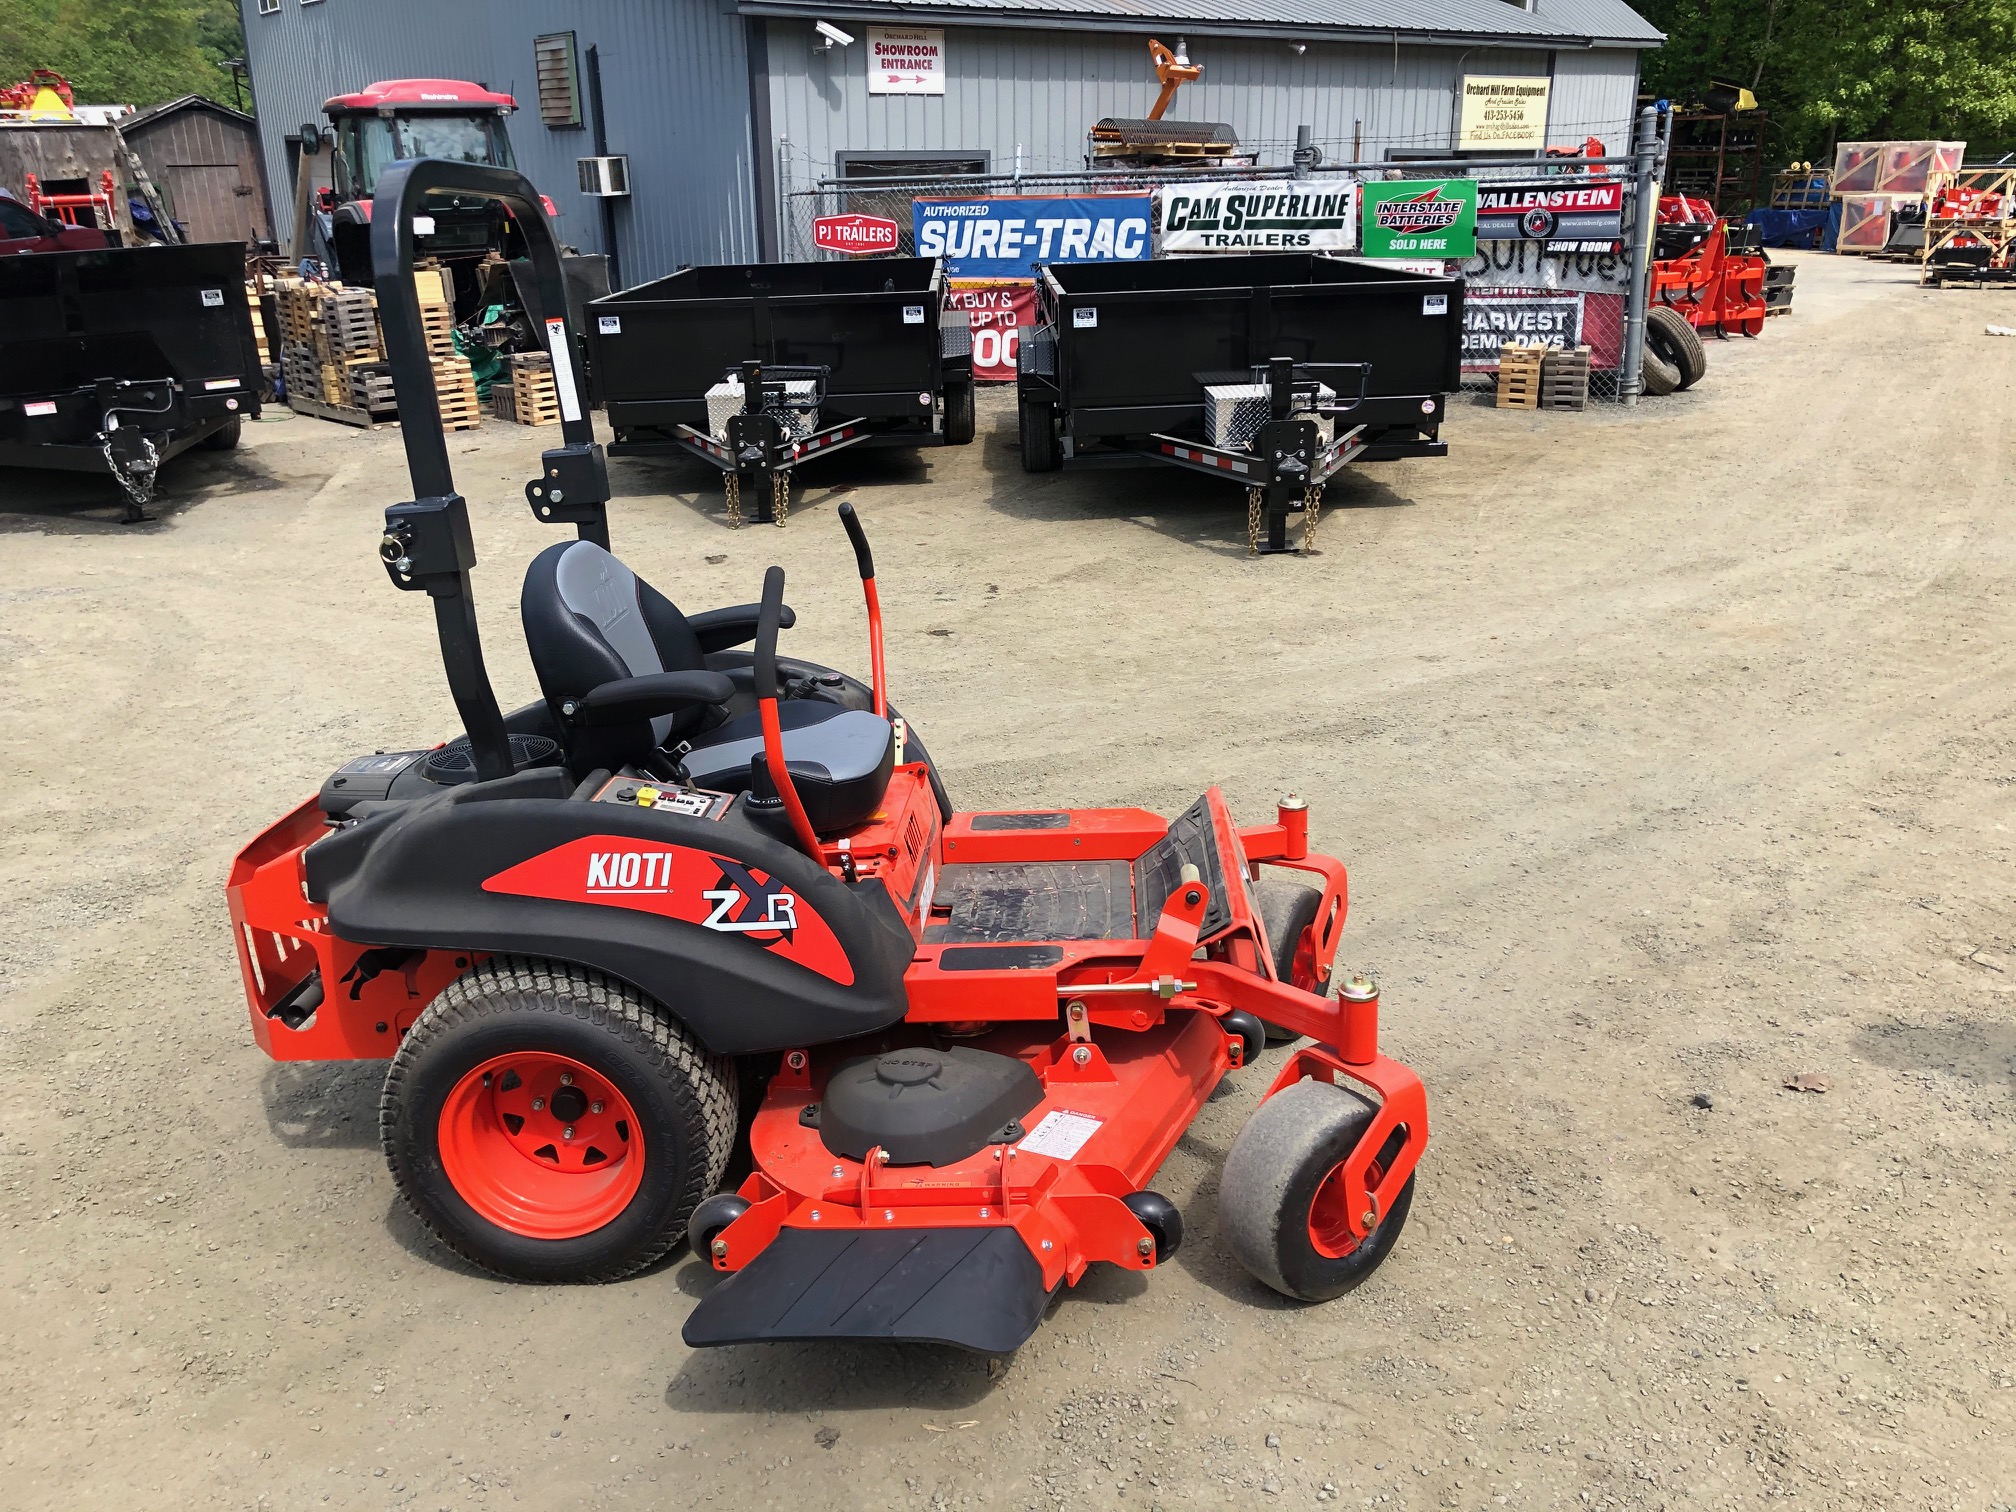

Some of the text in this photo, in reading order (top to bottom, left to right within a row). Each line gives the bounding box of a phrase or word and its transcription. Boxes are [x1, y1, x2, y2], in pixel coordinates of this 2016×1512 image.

[874, 42, 938, 56] SHOWROOM
[881, 58, 933, 70] ENTRANCE
[1466, 83, 1546, 97] Orchard Hill Farm Equipment
[1484, 110, 1524, 120] 413-253-5456
[923, 205, 989, 217] AUTHORIZED
[1166, 197, 1221, 232] CAM
[1222, 194, 1350, 231] SUPERLINE
[1377, 202, 1461, 213] INTERSTATE
[1380, 214, 1454, 225] BATTERIES
[819, 225, 892, 242] PJ TRAILERS
[919, 217, 1147, 259] SURE-TRAC
[1201, 234, 1311, 247] TRAILERS
[1389, 239, 1447, 250] SOLD HERE
[1547, 242, 1612, 253] SHOW ROOM
[963, 292, 997, 308] BUY
[1001, 292, 1013, 308] &
[970, 311, 1016, 327] UP TO
[1463, 311, 1567, 330] HARVEST
[586, 852, 673, 887] KIOTI
[1070, 1111, 1096, 1119] DANGER
